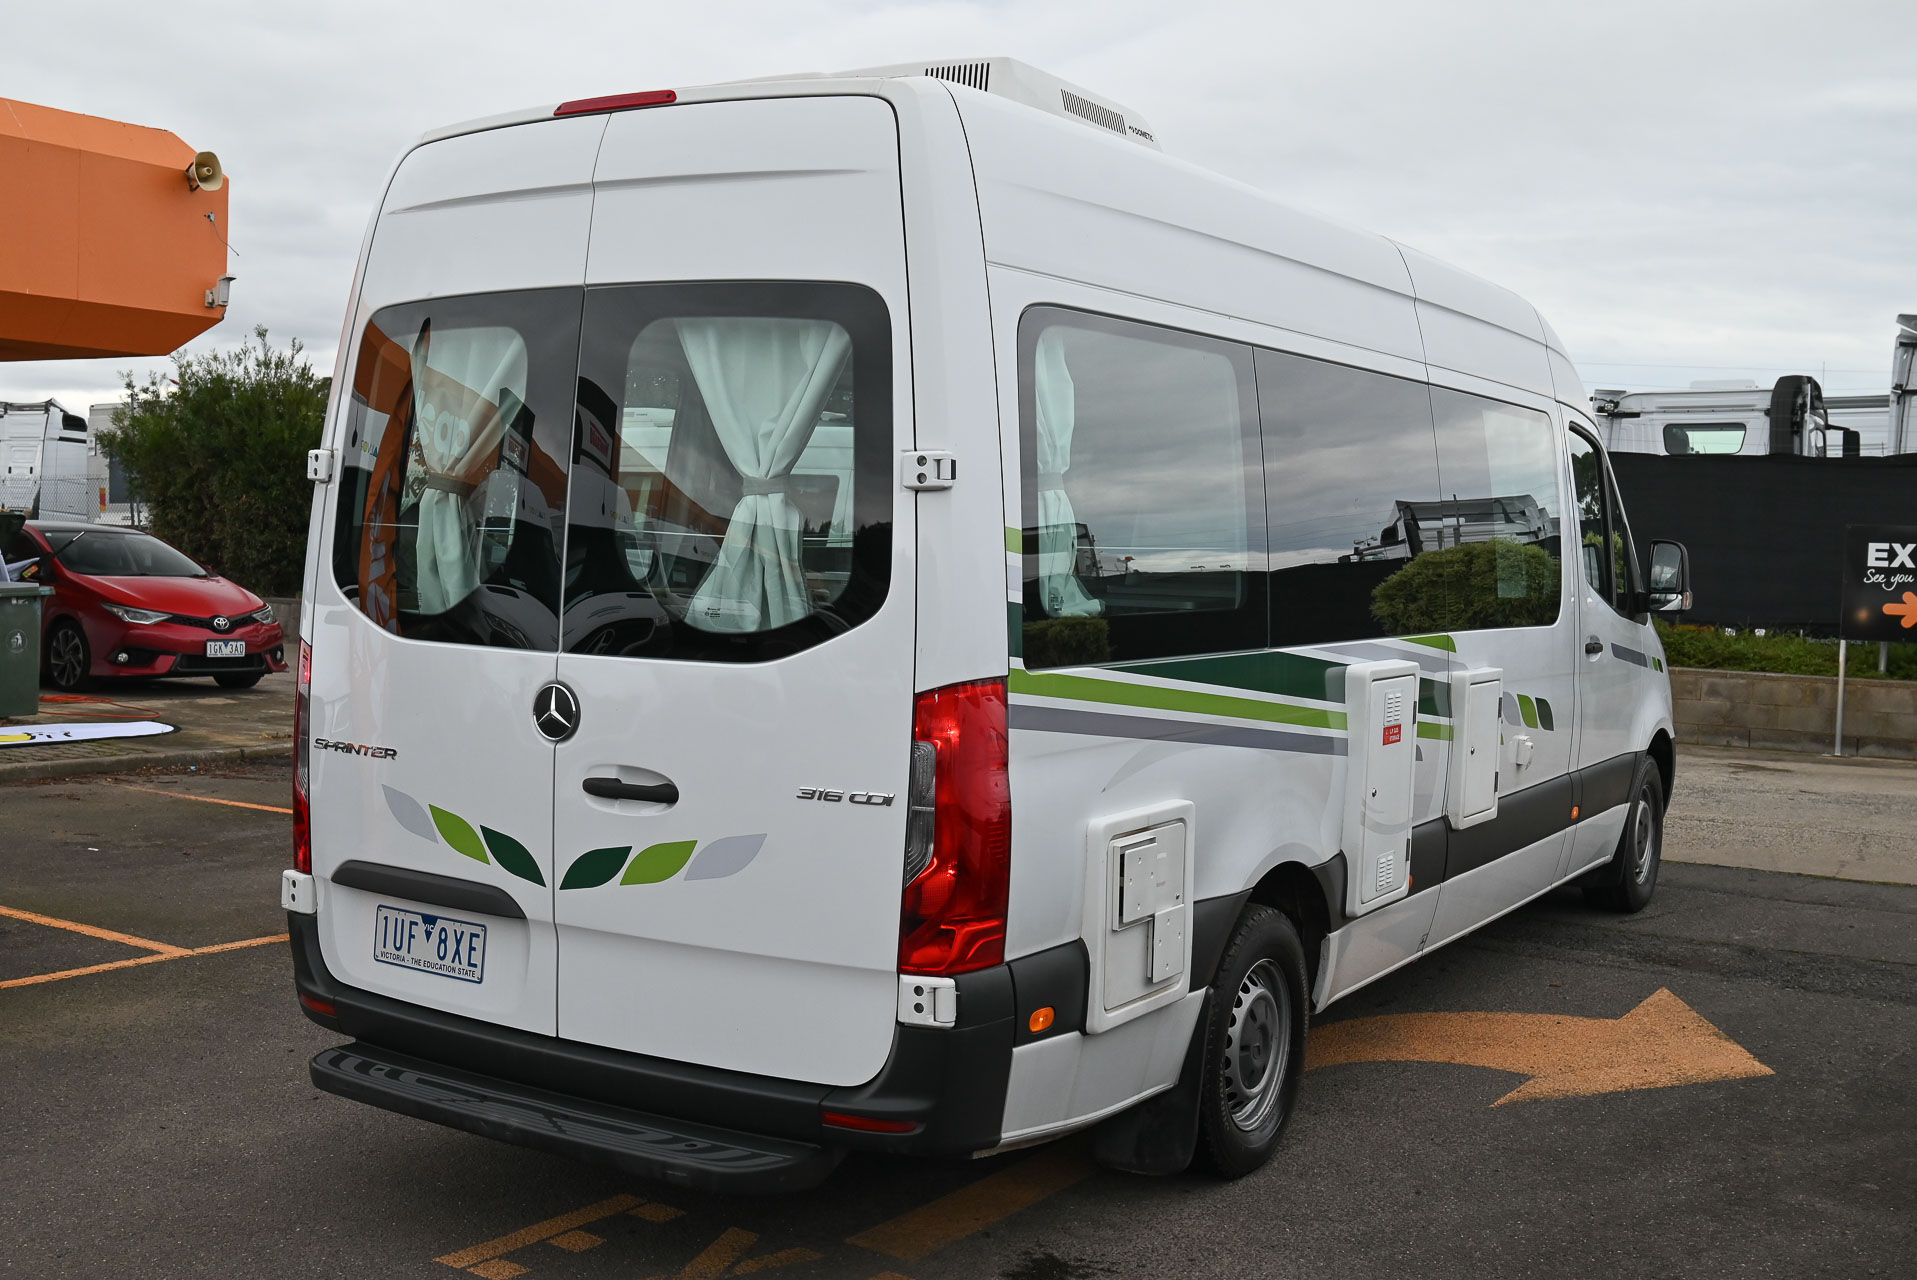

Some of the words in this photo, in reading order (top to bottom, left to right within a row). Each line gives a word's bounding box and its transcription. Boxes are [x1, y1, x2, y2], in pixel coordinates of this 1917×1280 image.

[1863, 569, 1887, 583] See
[1882, 574, 1915, 591] you
[209, 643, 223, 654] 1GK
[313, 738, 397, 760] SPRINTER
[796, 786, 844, 803] 316
[848, 791, 895, 807] CDI
[382, 915, 419, 954] 1UF
[437, 926, 480, 969] 8XE
[380, 951, 406, 963] VICTORIA
[411, 957, 422, 967] THE
[423, 960, 456, 974] EDUCATION
[457, 967, 476, 978] STATE
